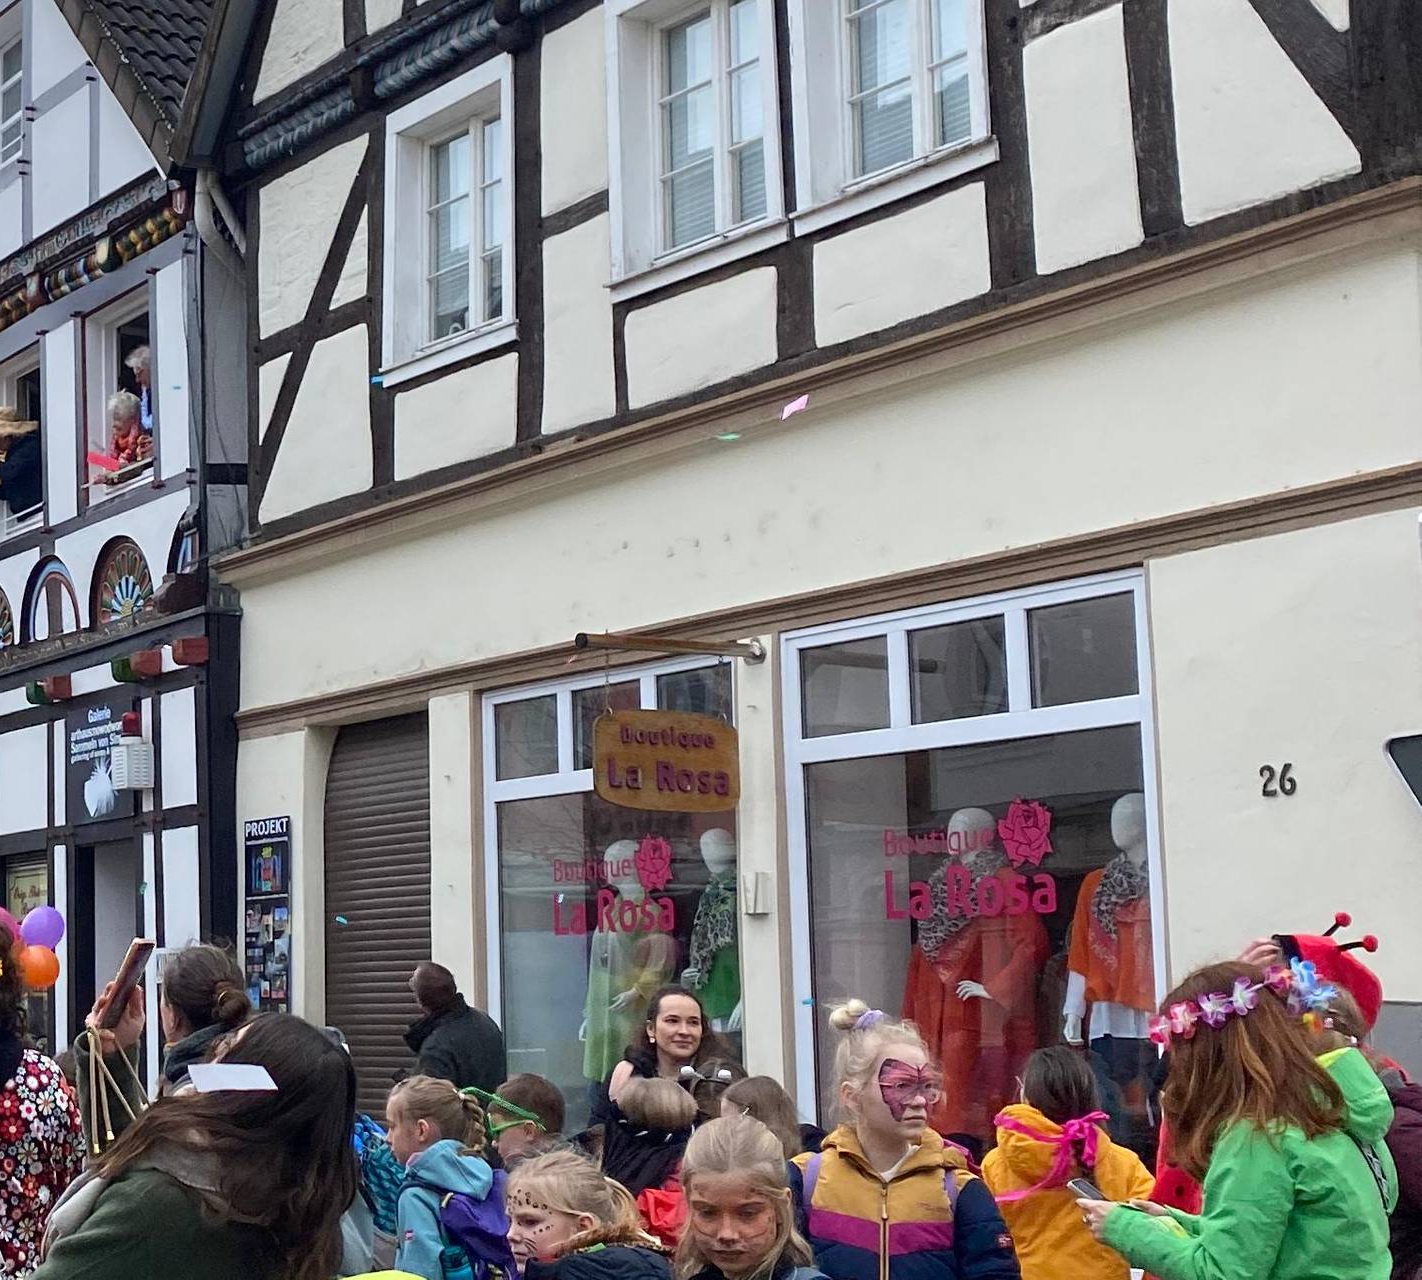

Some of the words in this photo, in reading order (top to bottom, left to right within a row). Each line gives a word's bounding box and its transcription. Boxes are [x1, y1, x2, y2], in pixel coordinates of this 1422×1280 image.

[620, 725, 716, 751] Boutique
[606, 758, 643, 790] La
[656, 760, 731, 796] Rosa
[1259, 763, 1297, 797] 26
[245, 818, 288, 837] PROJEKT
[882, 826, 996, 857] Boutique
[553, 858, 633, 884] Boutique
[884, 870, 932, 919] La
[946, 865, 1057, 917] Rosa
[554, 892, 587, 935] La
[597, 889, 675, 933] Rosa
